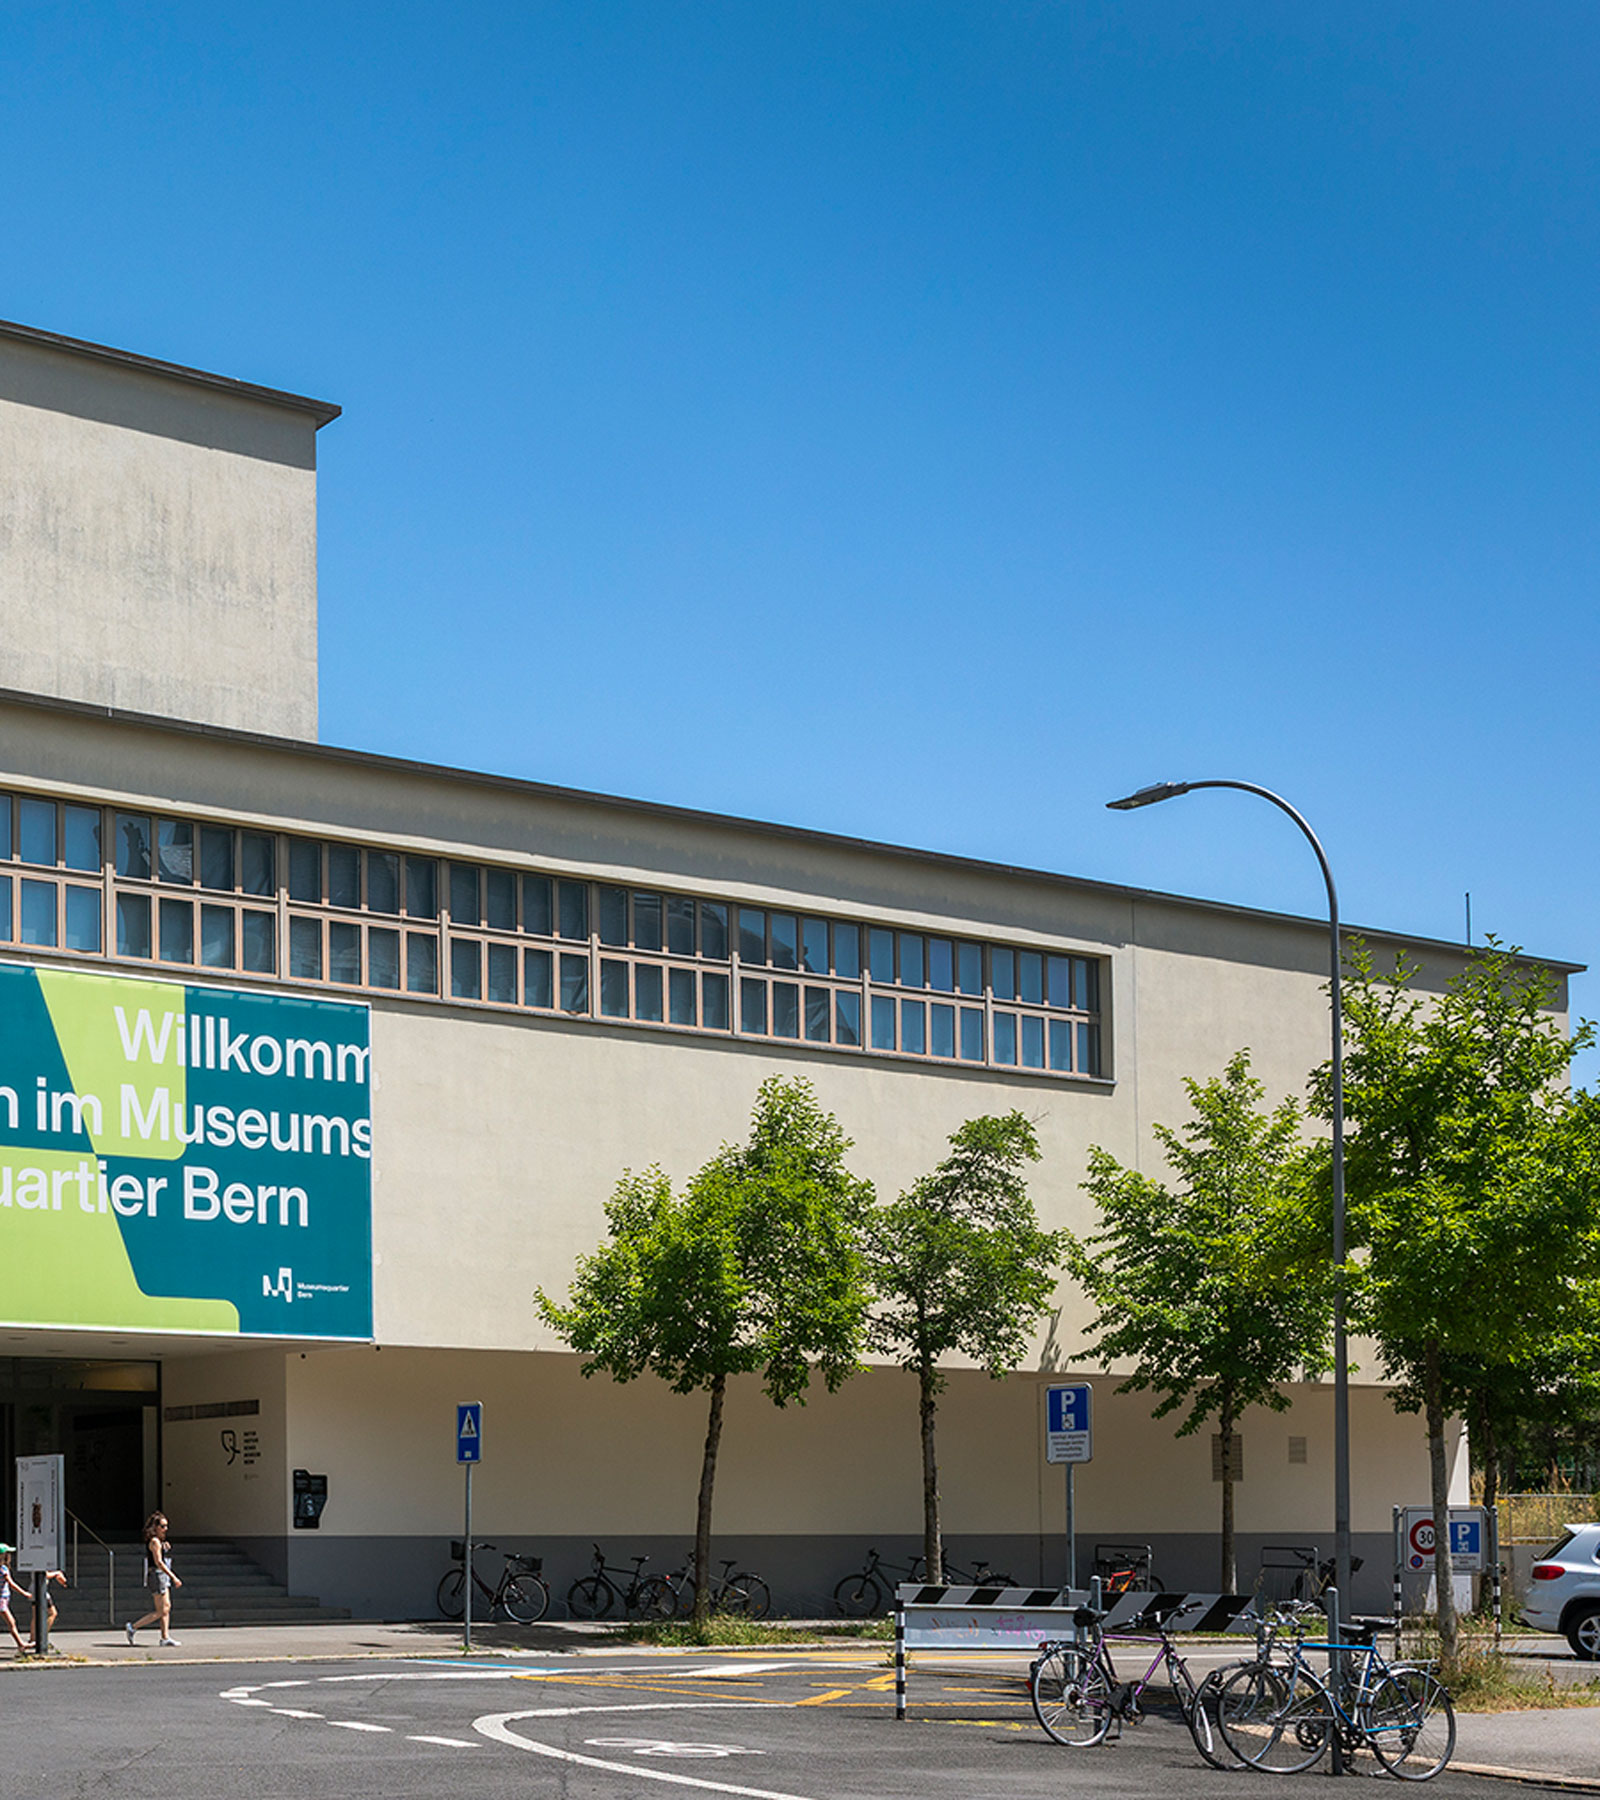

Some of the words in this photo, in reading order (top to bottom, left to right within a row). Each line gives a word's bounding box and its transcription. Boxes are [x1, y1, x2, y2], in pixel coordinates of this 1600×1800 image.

[114, 1005, 370, 1084] Willkomm
[36, 1076, 103, 1136] im
[120, 1083, 371, 1159] Museums
[183, 1165, 309, 1227] Bern
[1061, 1391, 1076, 1413] P
[1419, 1531, 1434, 1544] 30
[1458, 1524, 1471, 1540] P
